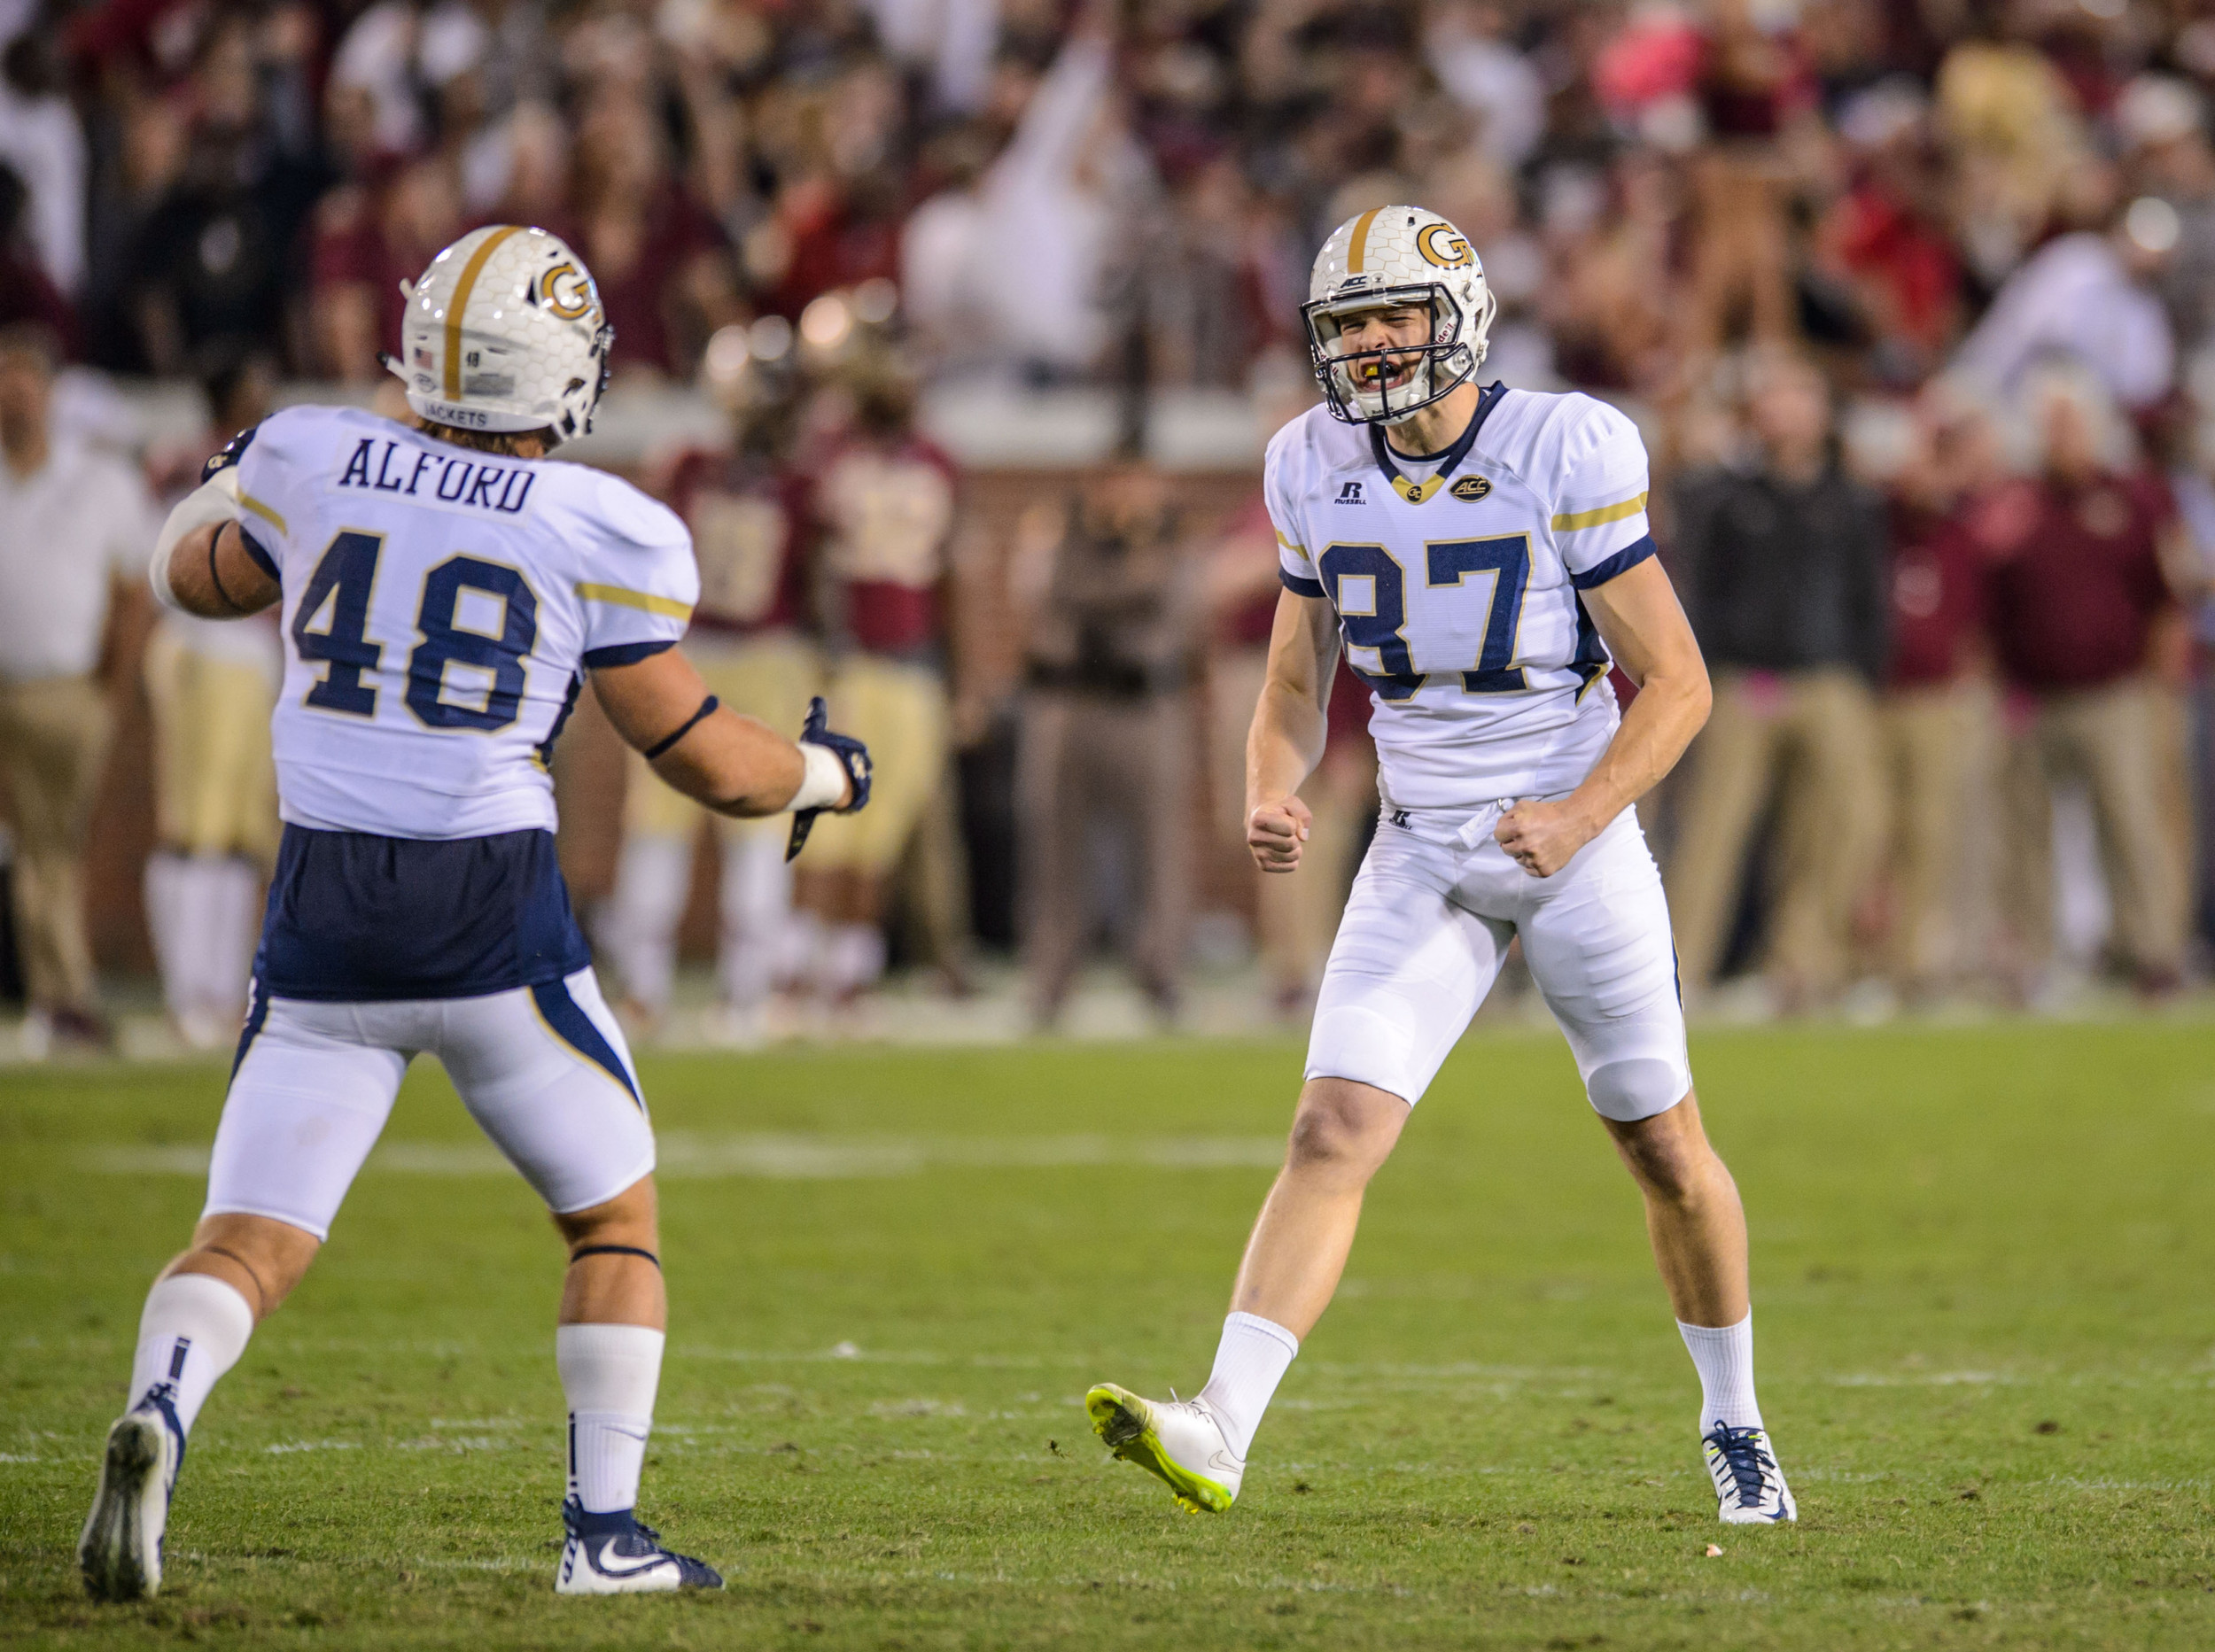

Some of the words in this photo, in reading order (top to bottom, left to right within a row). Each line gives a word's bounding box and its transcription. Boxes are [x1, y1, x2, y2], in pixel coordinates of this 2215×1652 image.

[1340, 275, 1368, 289] ACC
[424, 402, 488, 426] JACKETS
[339, 438, 535, 514] ALFORD
[1454, 480, 1488, 493] ACC
[1340, 482, 1362, 498] R
[1318, 531, 1534, 702] 87
[291, 526, 540, 735] 48
